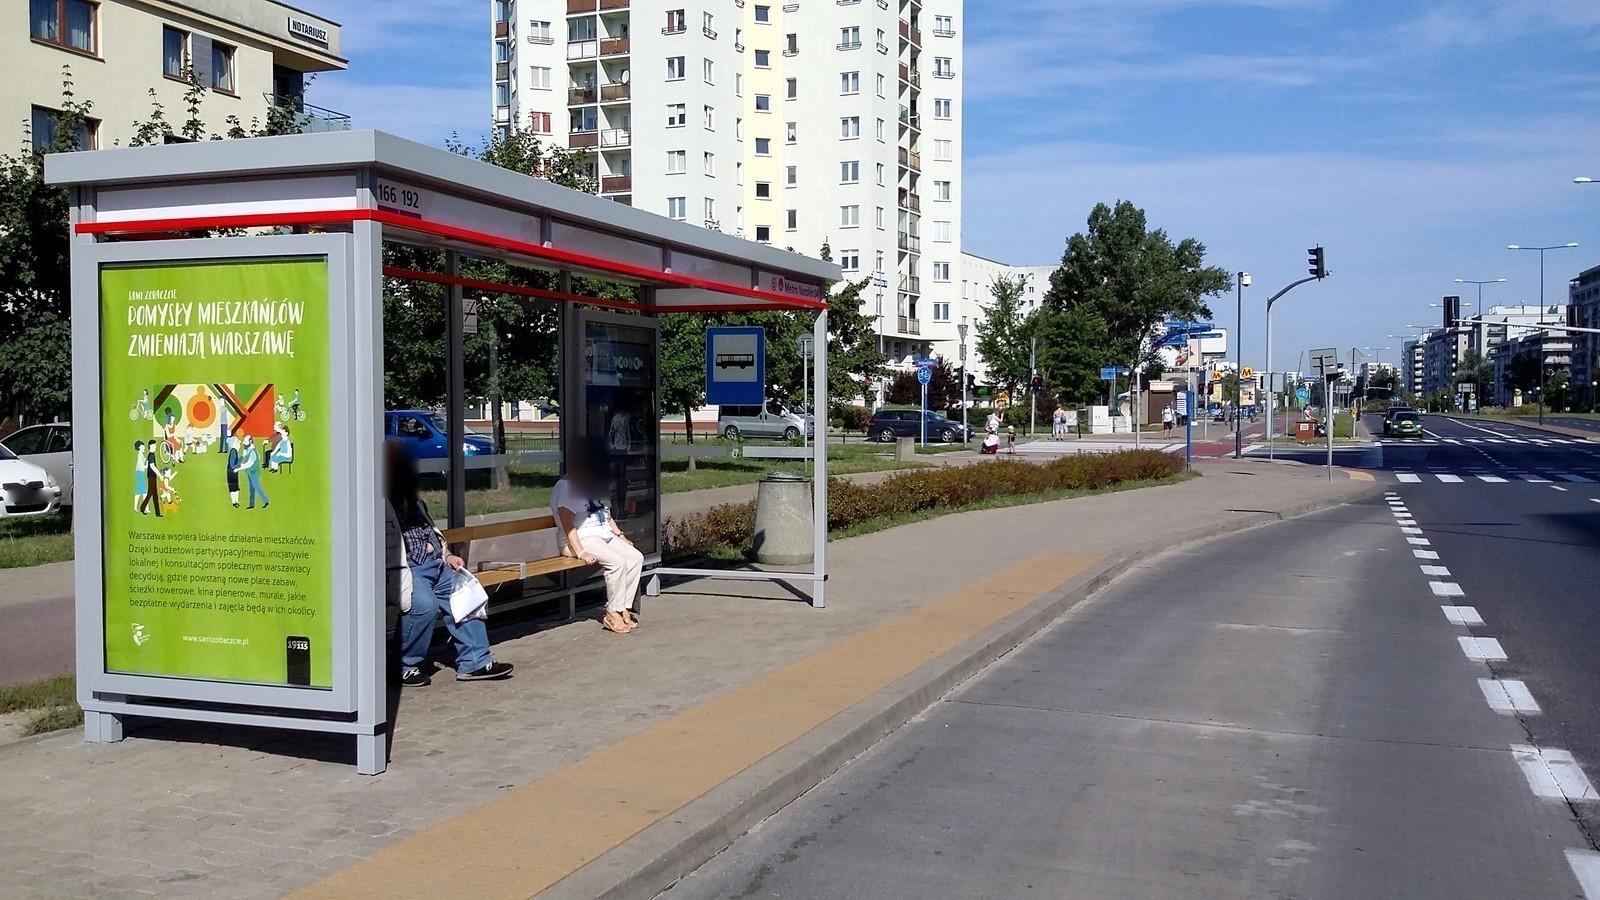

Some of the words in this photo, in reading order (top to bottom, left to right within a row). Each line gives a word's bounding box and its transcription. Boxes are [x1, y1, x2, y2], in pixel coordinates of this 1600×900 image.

[292, 20, 327, 41] NOTARIUSZ
[378, 184, 397, 203] 166
[402, 190, 420, 209] 192
[128, 290, 143, 301] SAMI
[145, 289, 177, 300] ZOBACZCIE
[784, 282, 798, 295] Metro
[128, 302, 193, 327] POMYSŁY
[198, 298, 304, 326] MIESZKAŃCÓW
[128, 332, 206, 359] ZMIENIAJĄ
[210, 330, 295, 358] WARSZAWĘ
[128, 530, 166, 540] Warszawa
[167, 532, 197, 542] wspiera
[199, 532, 227, 542] lokalne
[229, 534, 263, 543] działania
[128, 544, 152, 555] Dzięki
[153, 545, 194, 554] budżetowi
[268, 550, 310, 561] inicjatywie
[128, 558, 159, 568] lokalnej
[165, 559, 216, 570] konsultacjom
[217, 561, 263, 573] społecznym
[265, 565, 311, 576] warszawiacy
[129, 571, 165, 582] decydują,
[167, 573, 188, 583] gdzie
[189, 575, 227, 585] powstaną
[228, 576, 249, 584] nowe
[250, 576, 271, 586] place
[272, 578, 298, 587] zabaw,
[128, 584, 155, 594] ścieżki
[197, 586, 214, 596] kina
[215, 589, 258, 599] plenerowe,
[259, 591, 286, 601] murale,
[287, 592, 306, 602] jakie
[129, 598, 168, 608] bezpłatne
[169, 600, 213, 610] wydarzenia
[218, 602, 245, 613] zajęcia
[246, 603, 266, 615] będą
[275, 605, 286, 614] ich
[182, 635, 249, 647] www.samizobaczcie.pl
